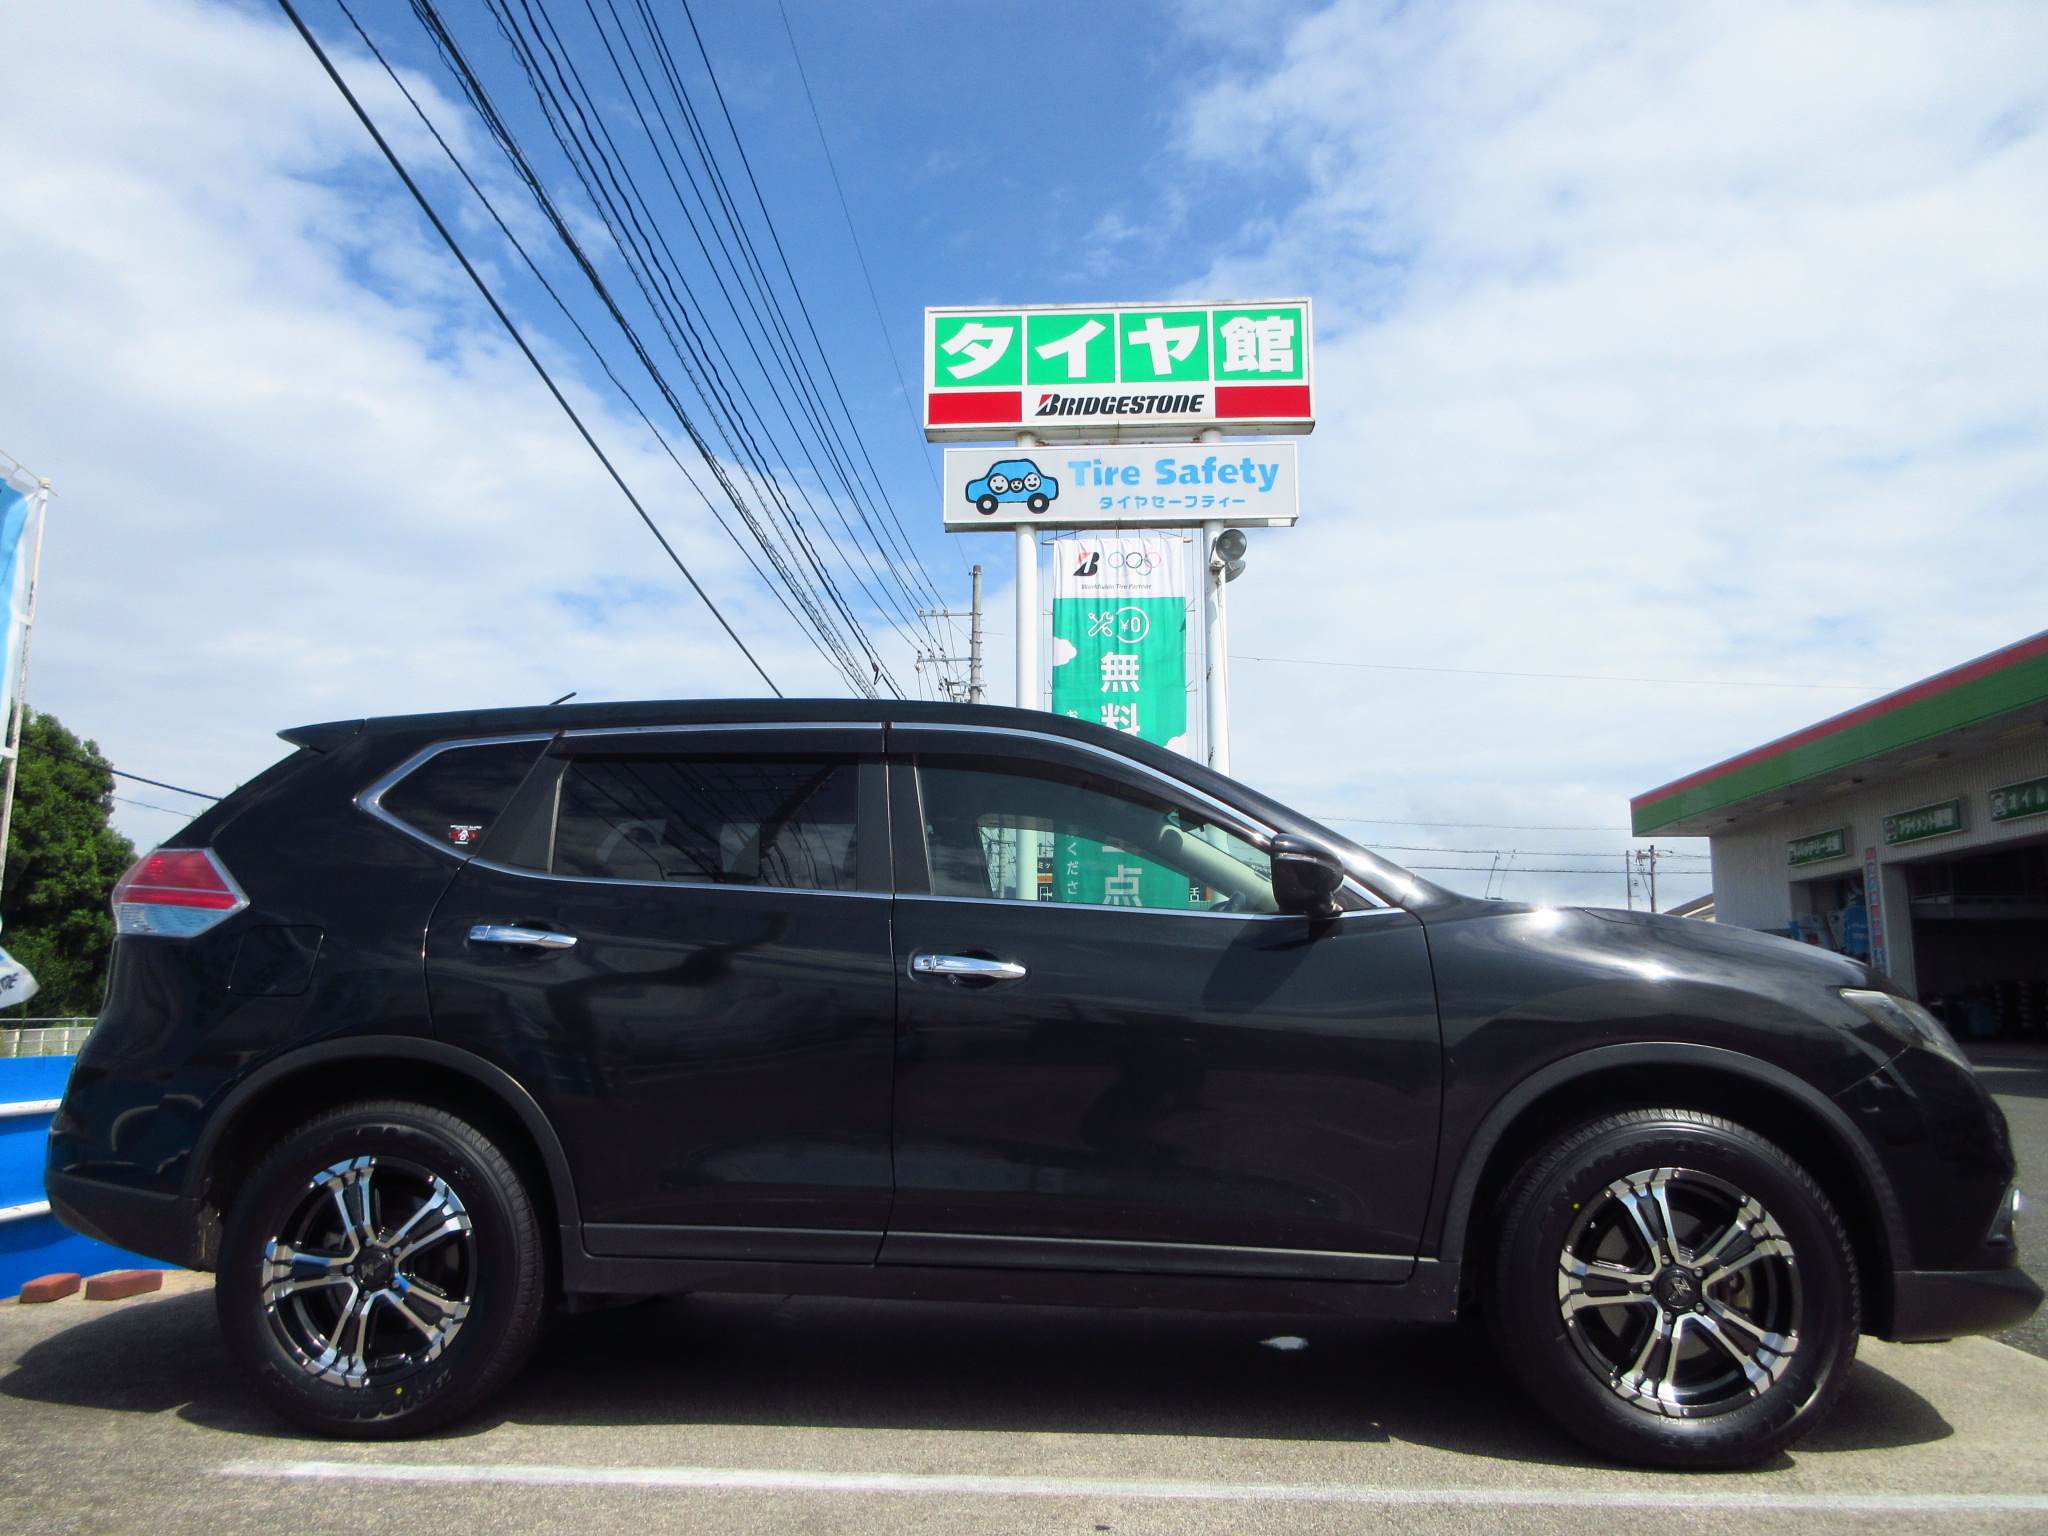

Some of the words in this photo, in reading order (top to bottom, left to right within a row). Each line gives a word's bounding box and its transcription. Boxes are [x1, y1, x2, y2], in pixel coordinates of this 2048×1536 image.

[940, 315, 1295, 379] タイヤ館
[1035, 393, 1205, 417] BRIDGESTONE
[1068, 459, 1140, 487] Tire
[1156, 456, 1279, 492] Safety
[1099, 495, 1245, 510] タイヤセーフティー
